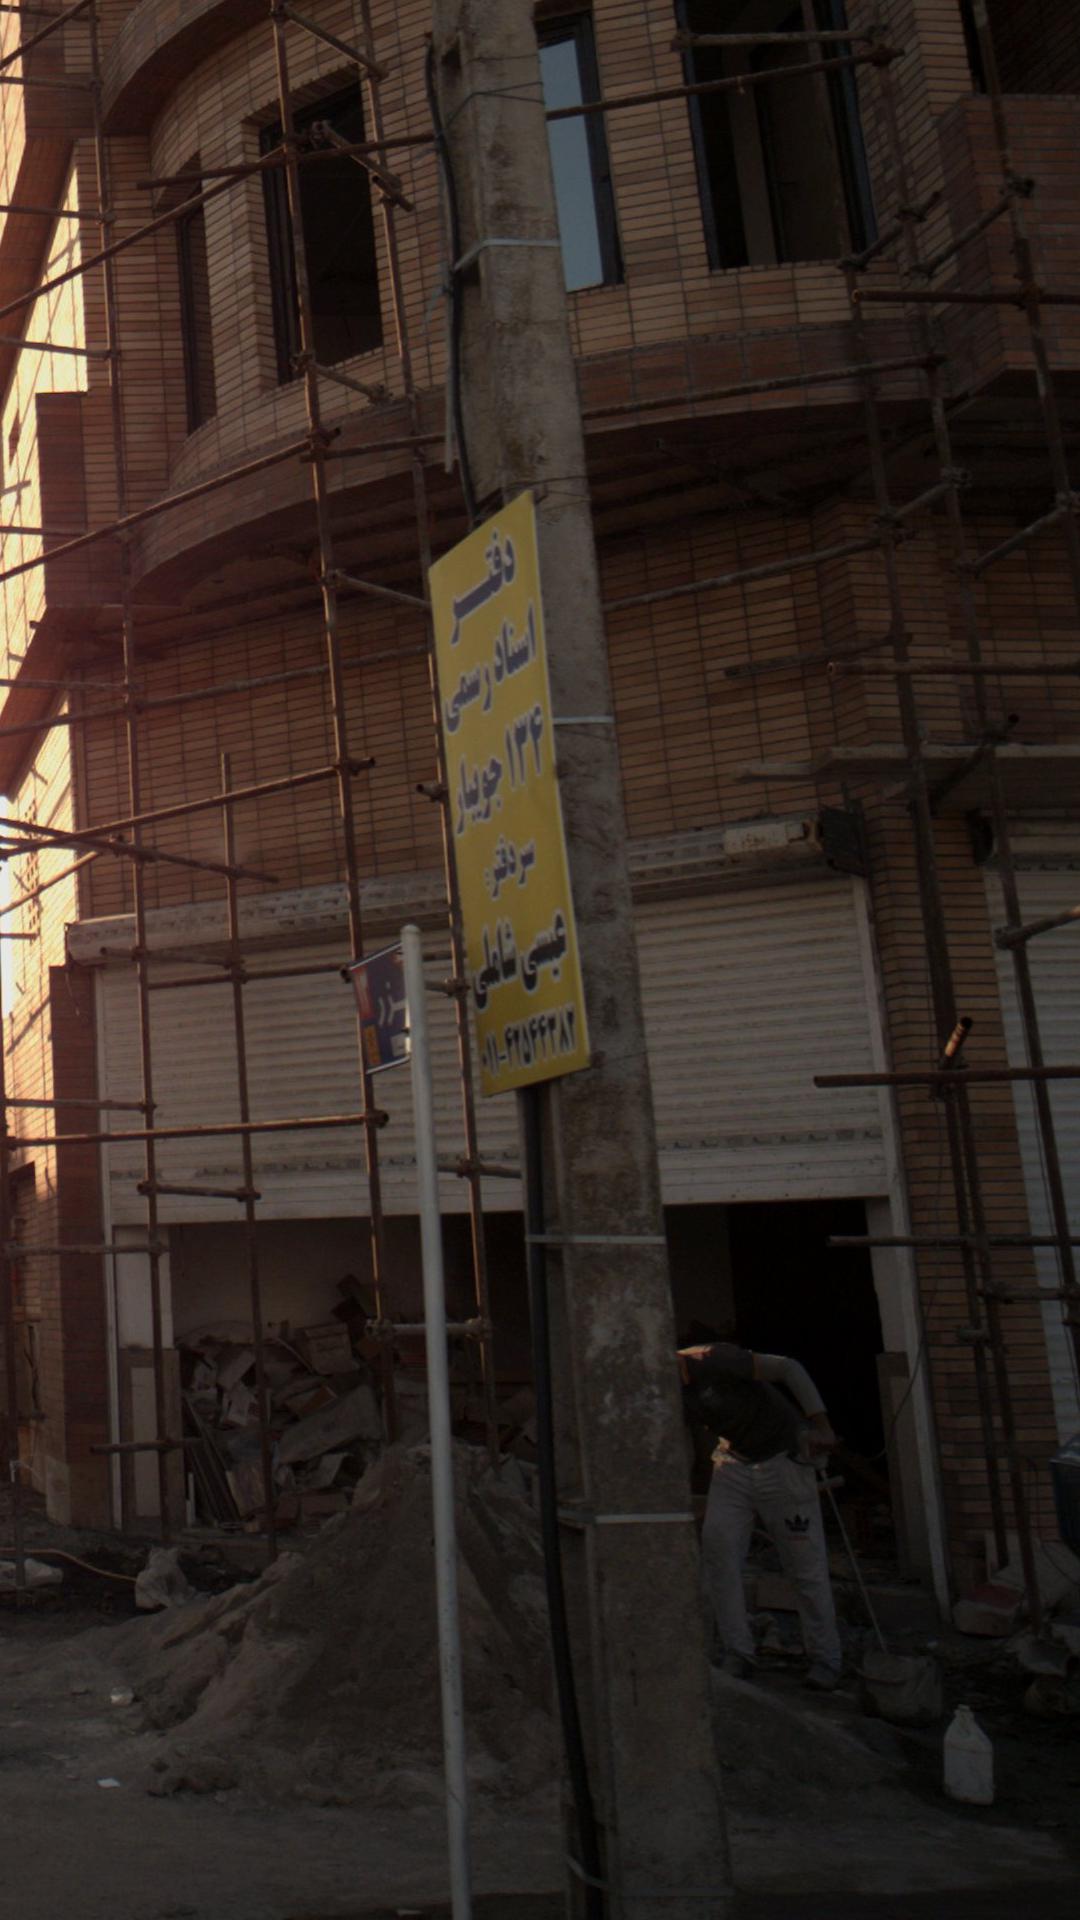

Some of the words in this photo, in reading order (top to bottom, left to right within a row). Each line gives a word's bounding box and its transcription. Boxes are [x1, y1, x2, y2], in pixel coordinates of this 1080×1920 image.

[451, 529, 515, 644] دفتر
[495, 600, 536, 683] اسناد
[446, 666, 492, 733] رسمی
[457, 755, 502, 835] جویبار
